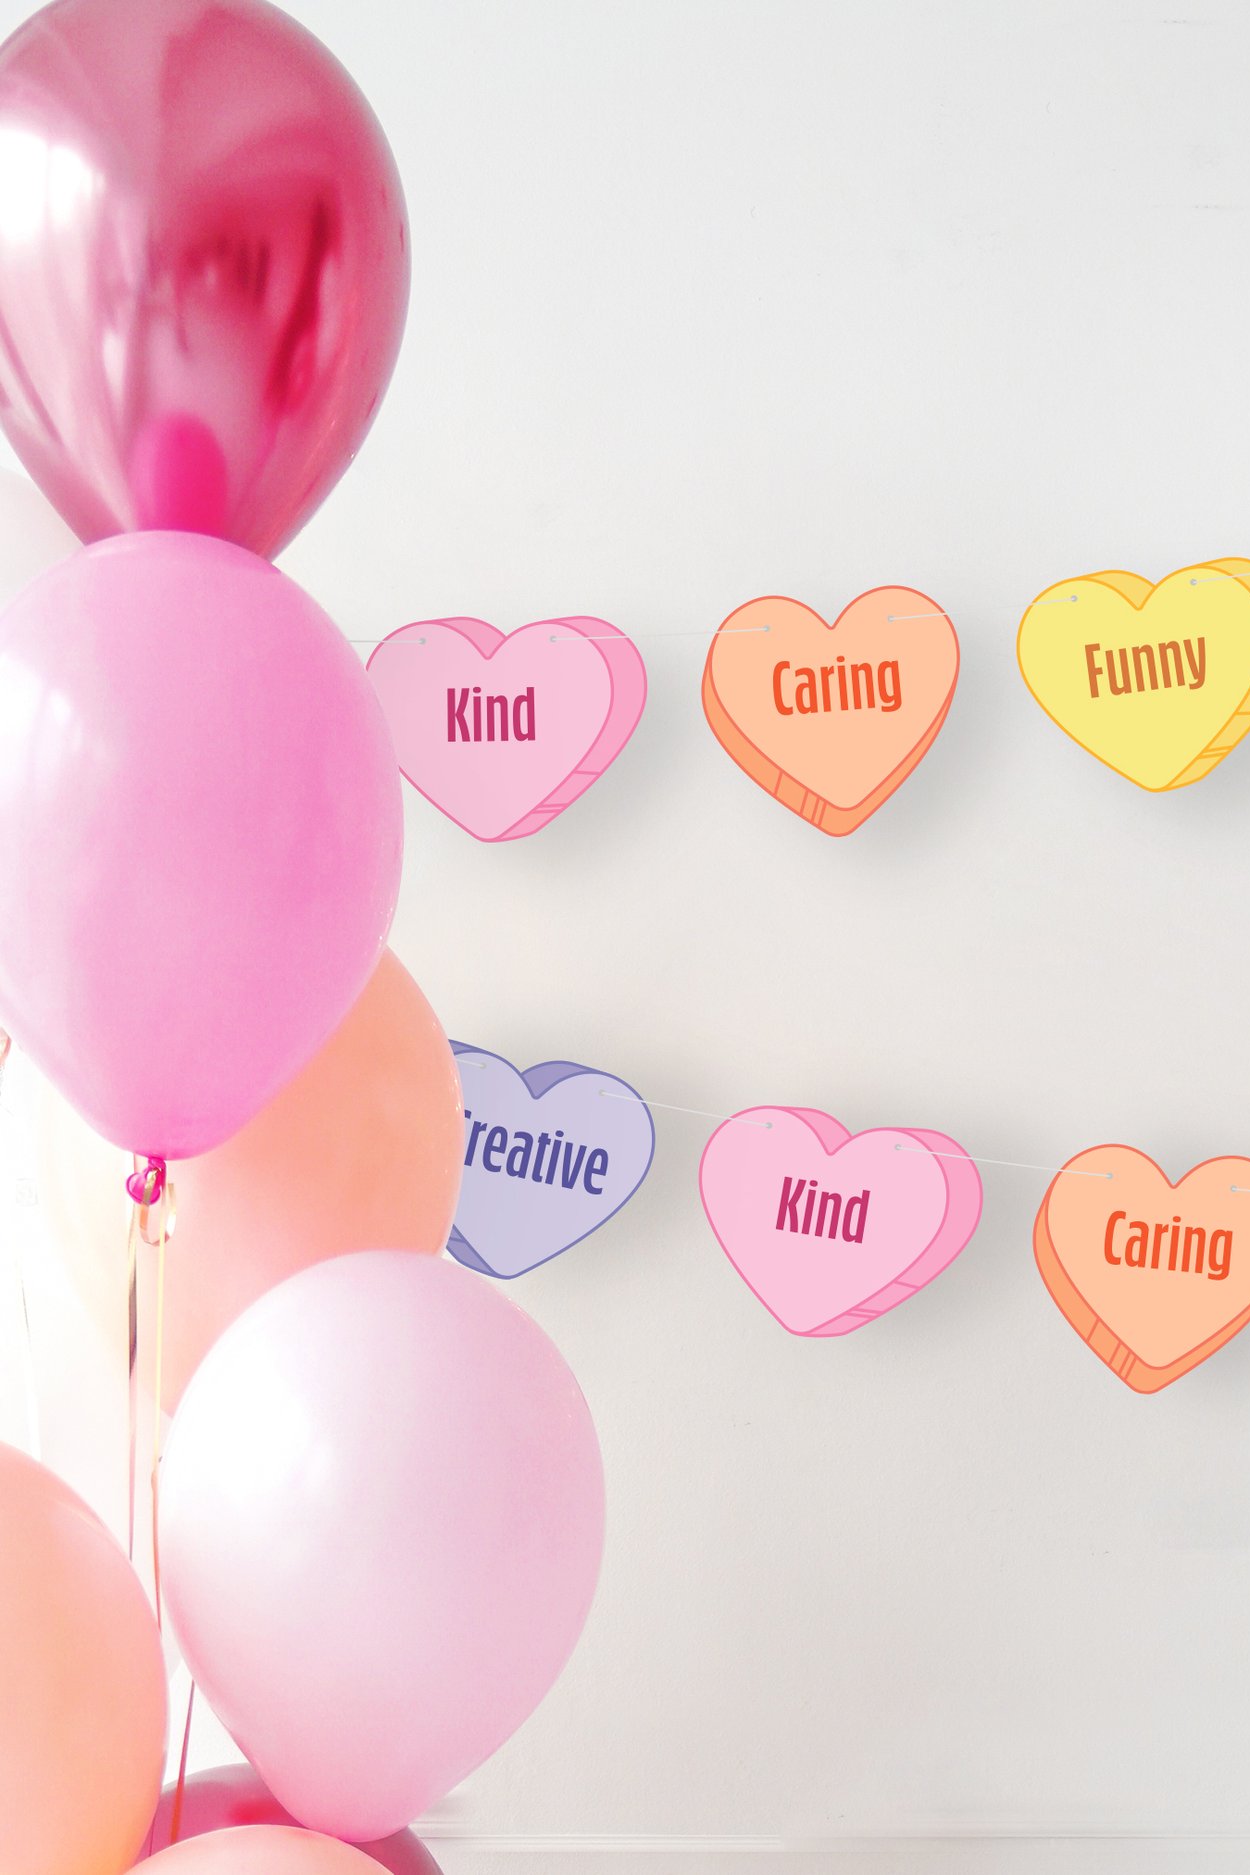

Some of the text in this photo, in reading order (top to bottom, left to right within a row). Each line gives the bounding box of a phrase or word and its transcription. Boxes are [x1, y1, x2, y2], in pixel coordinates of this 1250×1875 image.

[772, 655, 902, 716] Caring
[1084, 636, 1206, 699] Funny
[446, 686, 536, 743] Kind
[464, 1109, 609, 1195] reative
[775, 1176, 871, 1244] Kind
[1103, 1210, 1233, 1281] Caring
